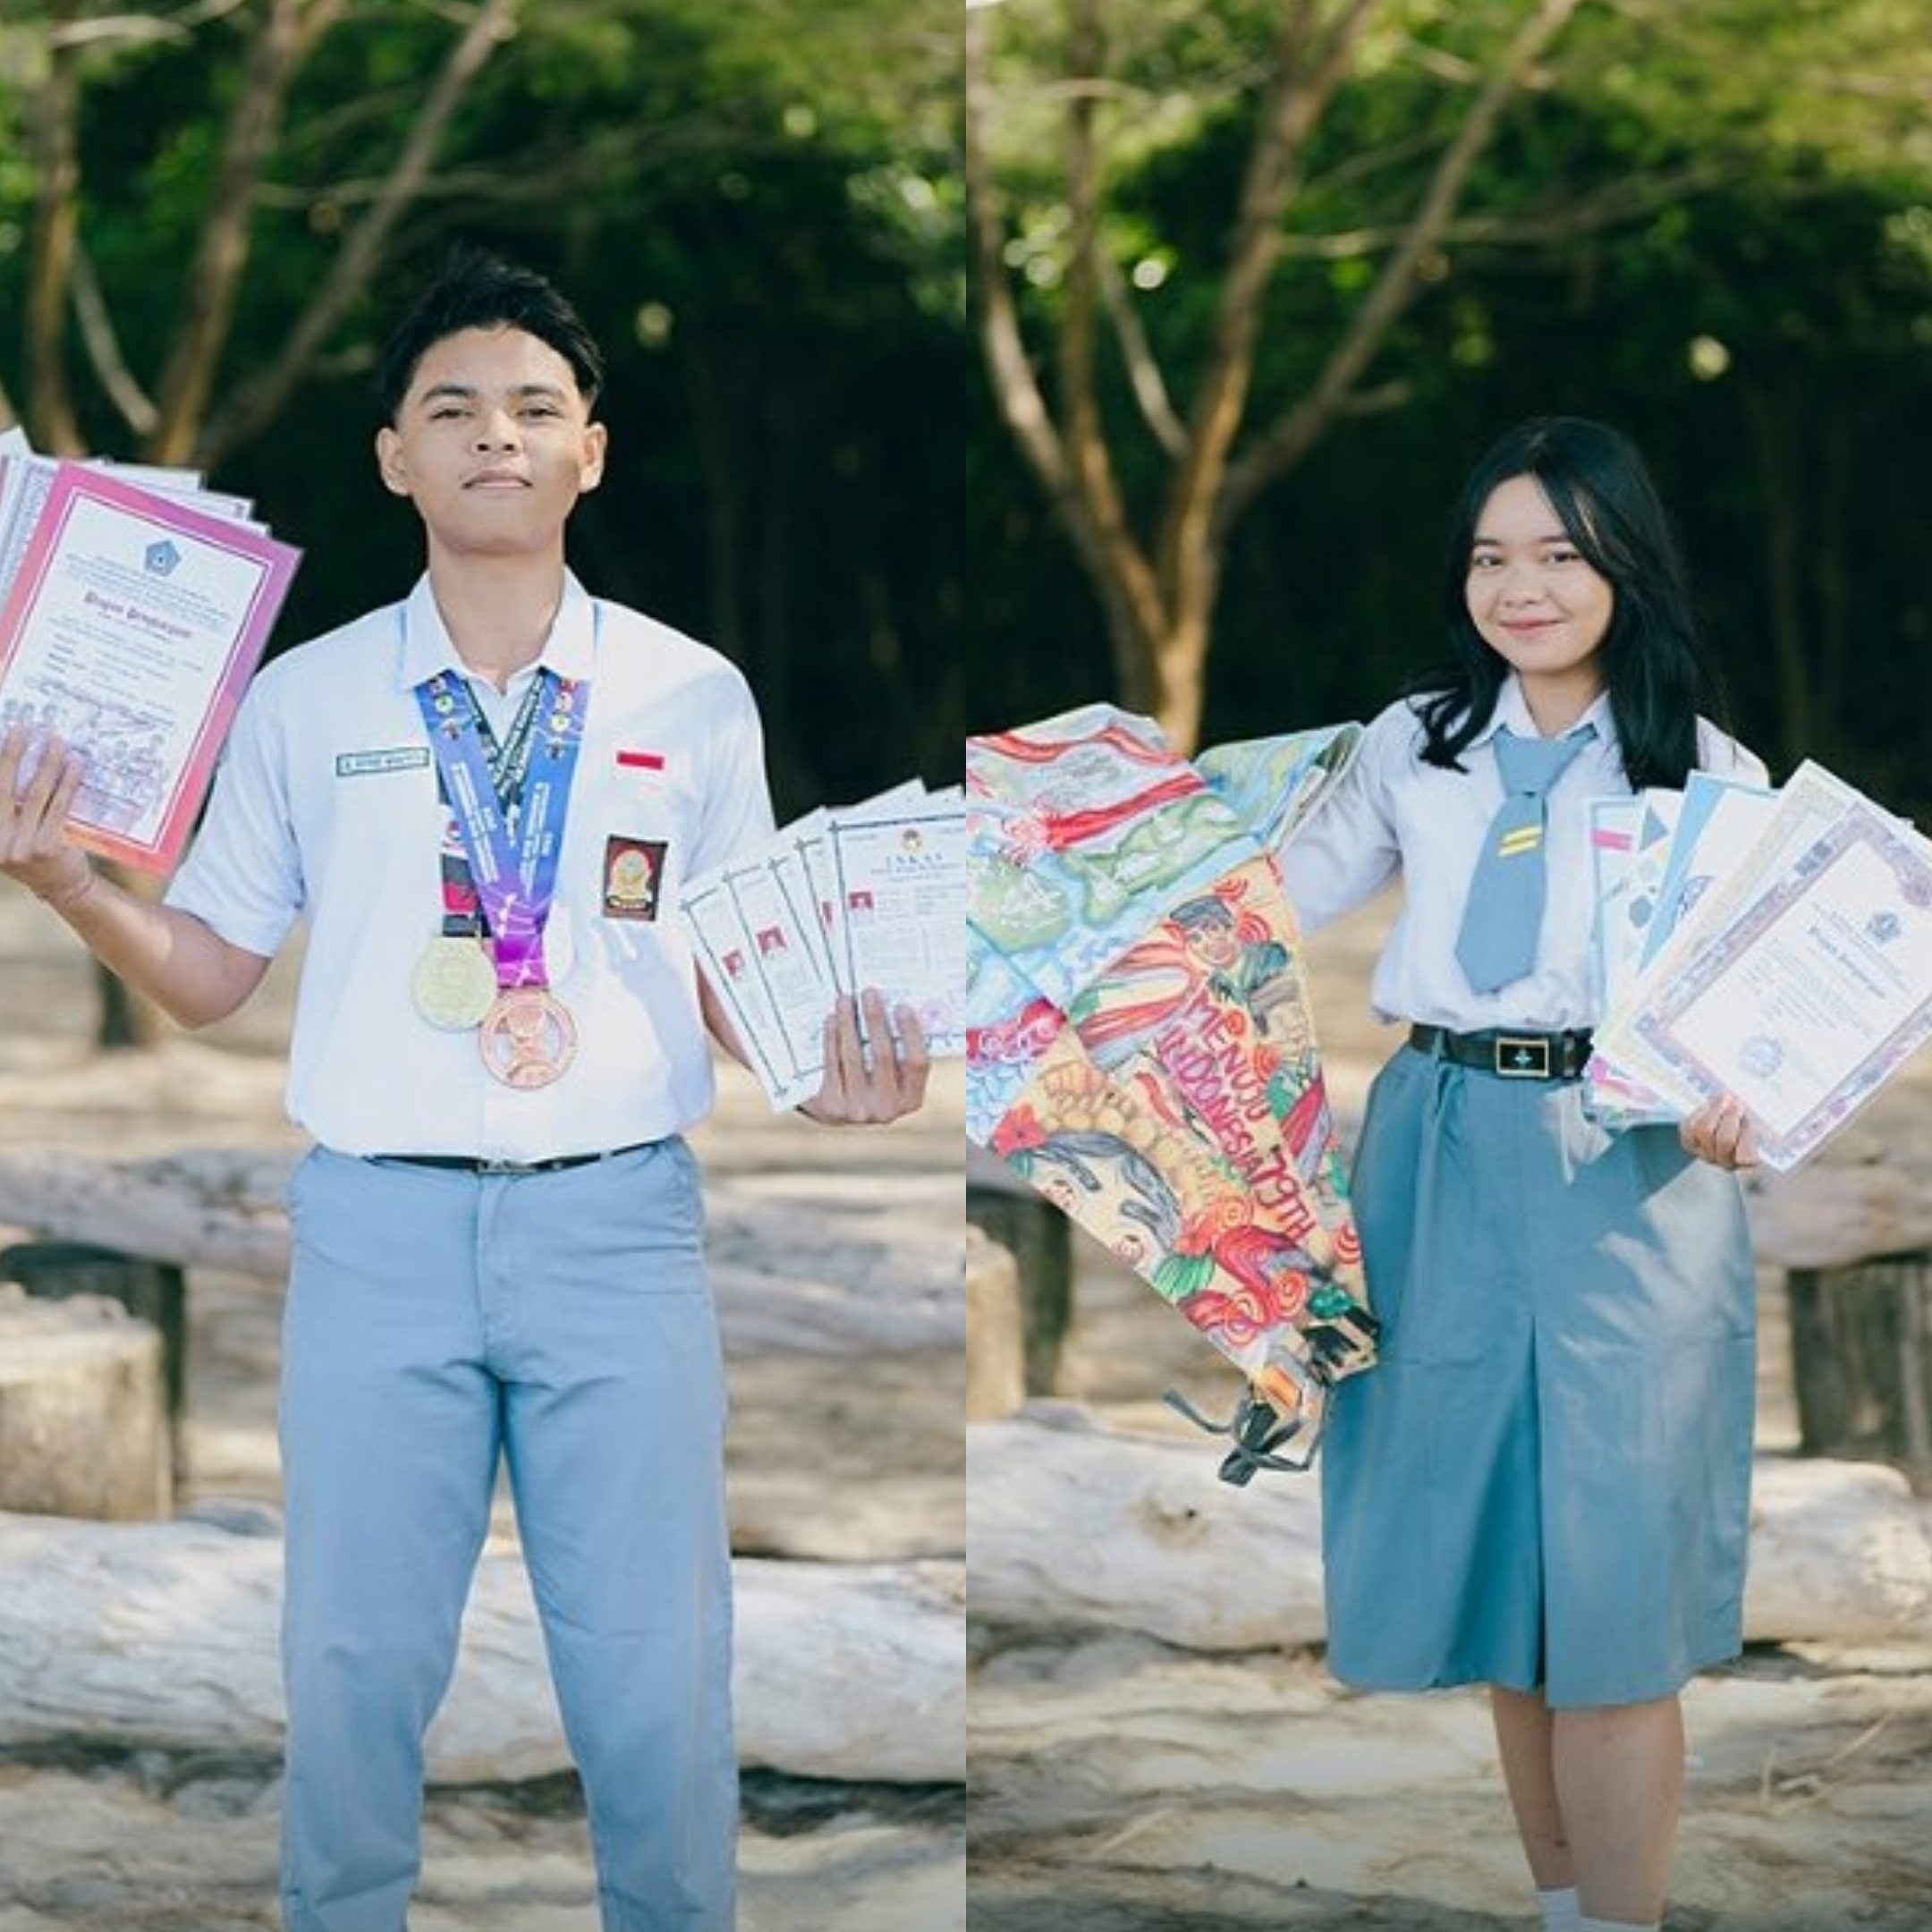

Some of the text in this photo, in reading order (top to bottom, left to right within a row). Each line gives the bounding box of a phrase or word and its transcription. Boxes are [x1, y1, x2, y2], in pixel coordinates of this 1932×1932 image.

[1157, 1027, 1317, 1241] INDONESIA 79TH
[1182, 989, 1272, 1121] MENUJU
